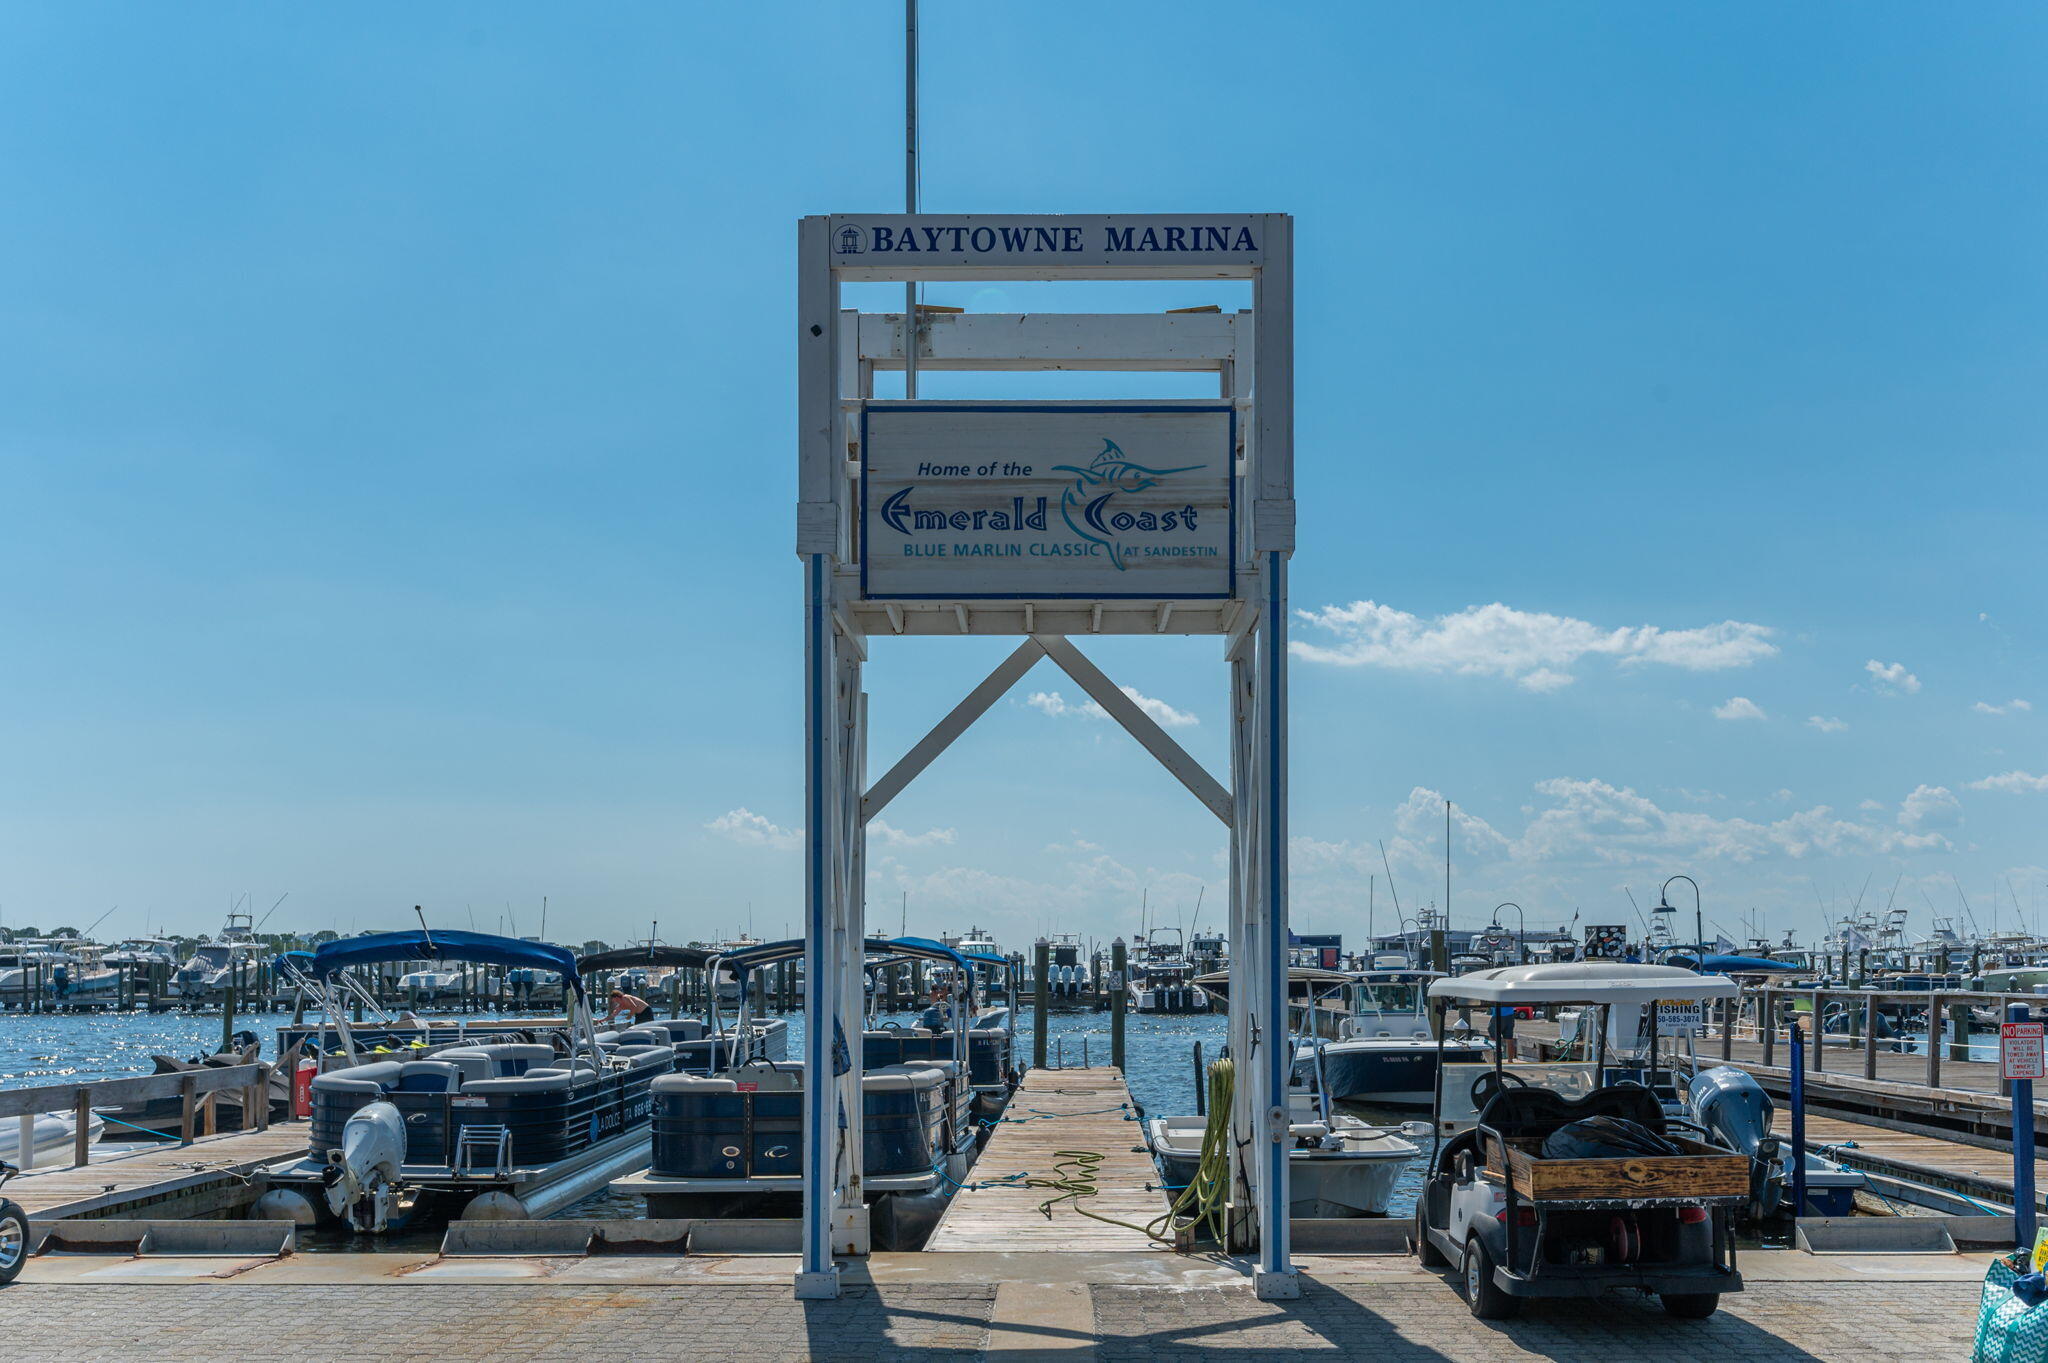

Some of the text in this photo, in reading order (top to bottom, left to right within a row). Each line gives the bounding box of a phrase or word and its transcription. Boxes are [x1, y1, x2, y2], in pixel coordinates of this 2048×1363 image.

[871, 226, 1258, 253] BAYTOWNE MARINA
[917, 461, 1032, 477] Home of the
[880, 486, 1198, 536] Emerald Coast
[903, 542, 1101, 558] BLUE MARLIN CLASSIC
[1123, 546, 1218, 557] AT SANDESTIN
[1657, 1005, 1700, 1014] ISHING
[1657, 1015, 1700, 1023] 50-585-3074
[2003, 1026, 2042, 1037] NO PARKING
[605, 1111, 620, 1130] DOLCE
